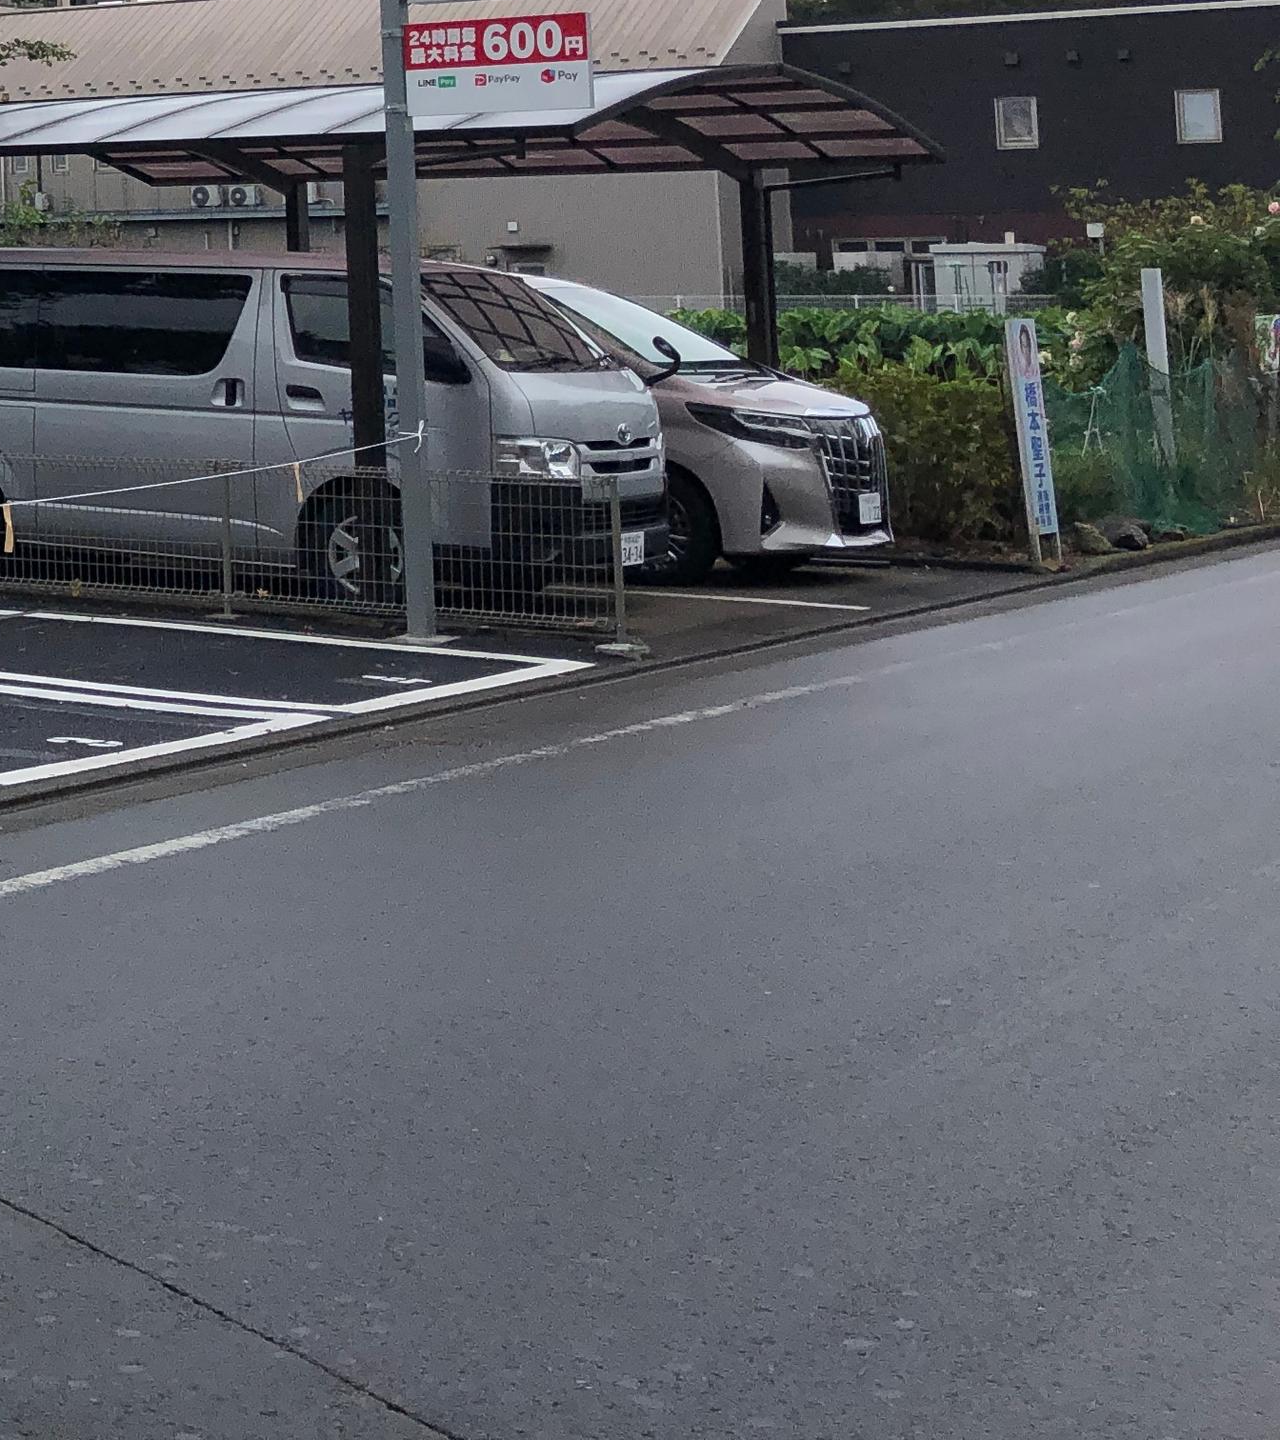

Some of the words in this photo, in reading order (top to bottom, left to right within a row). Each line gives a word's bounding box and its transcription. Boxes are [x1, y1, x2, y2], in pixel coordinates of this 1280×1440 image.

[483, 20, 584, 60] 600円
[488, 74, 521, 84] PayPay
[558, 70, 579, 80] Pay
[418, 79, 437, 87] LINE
